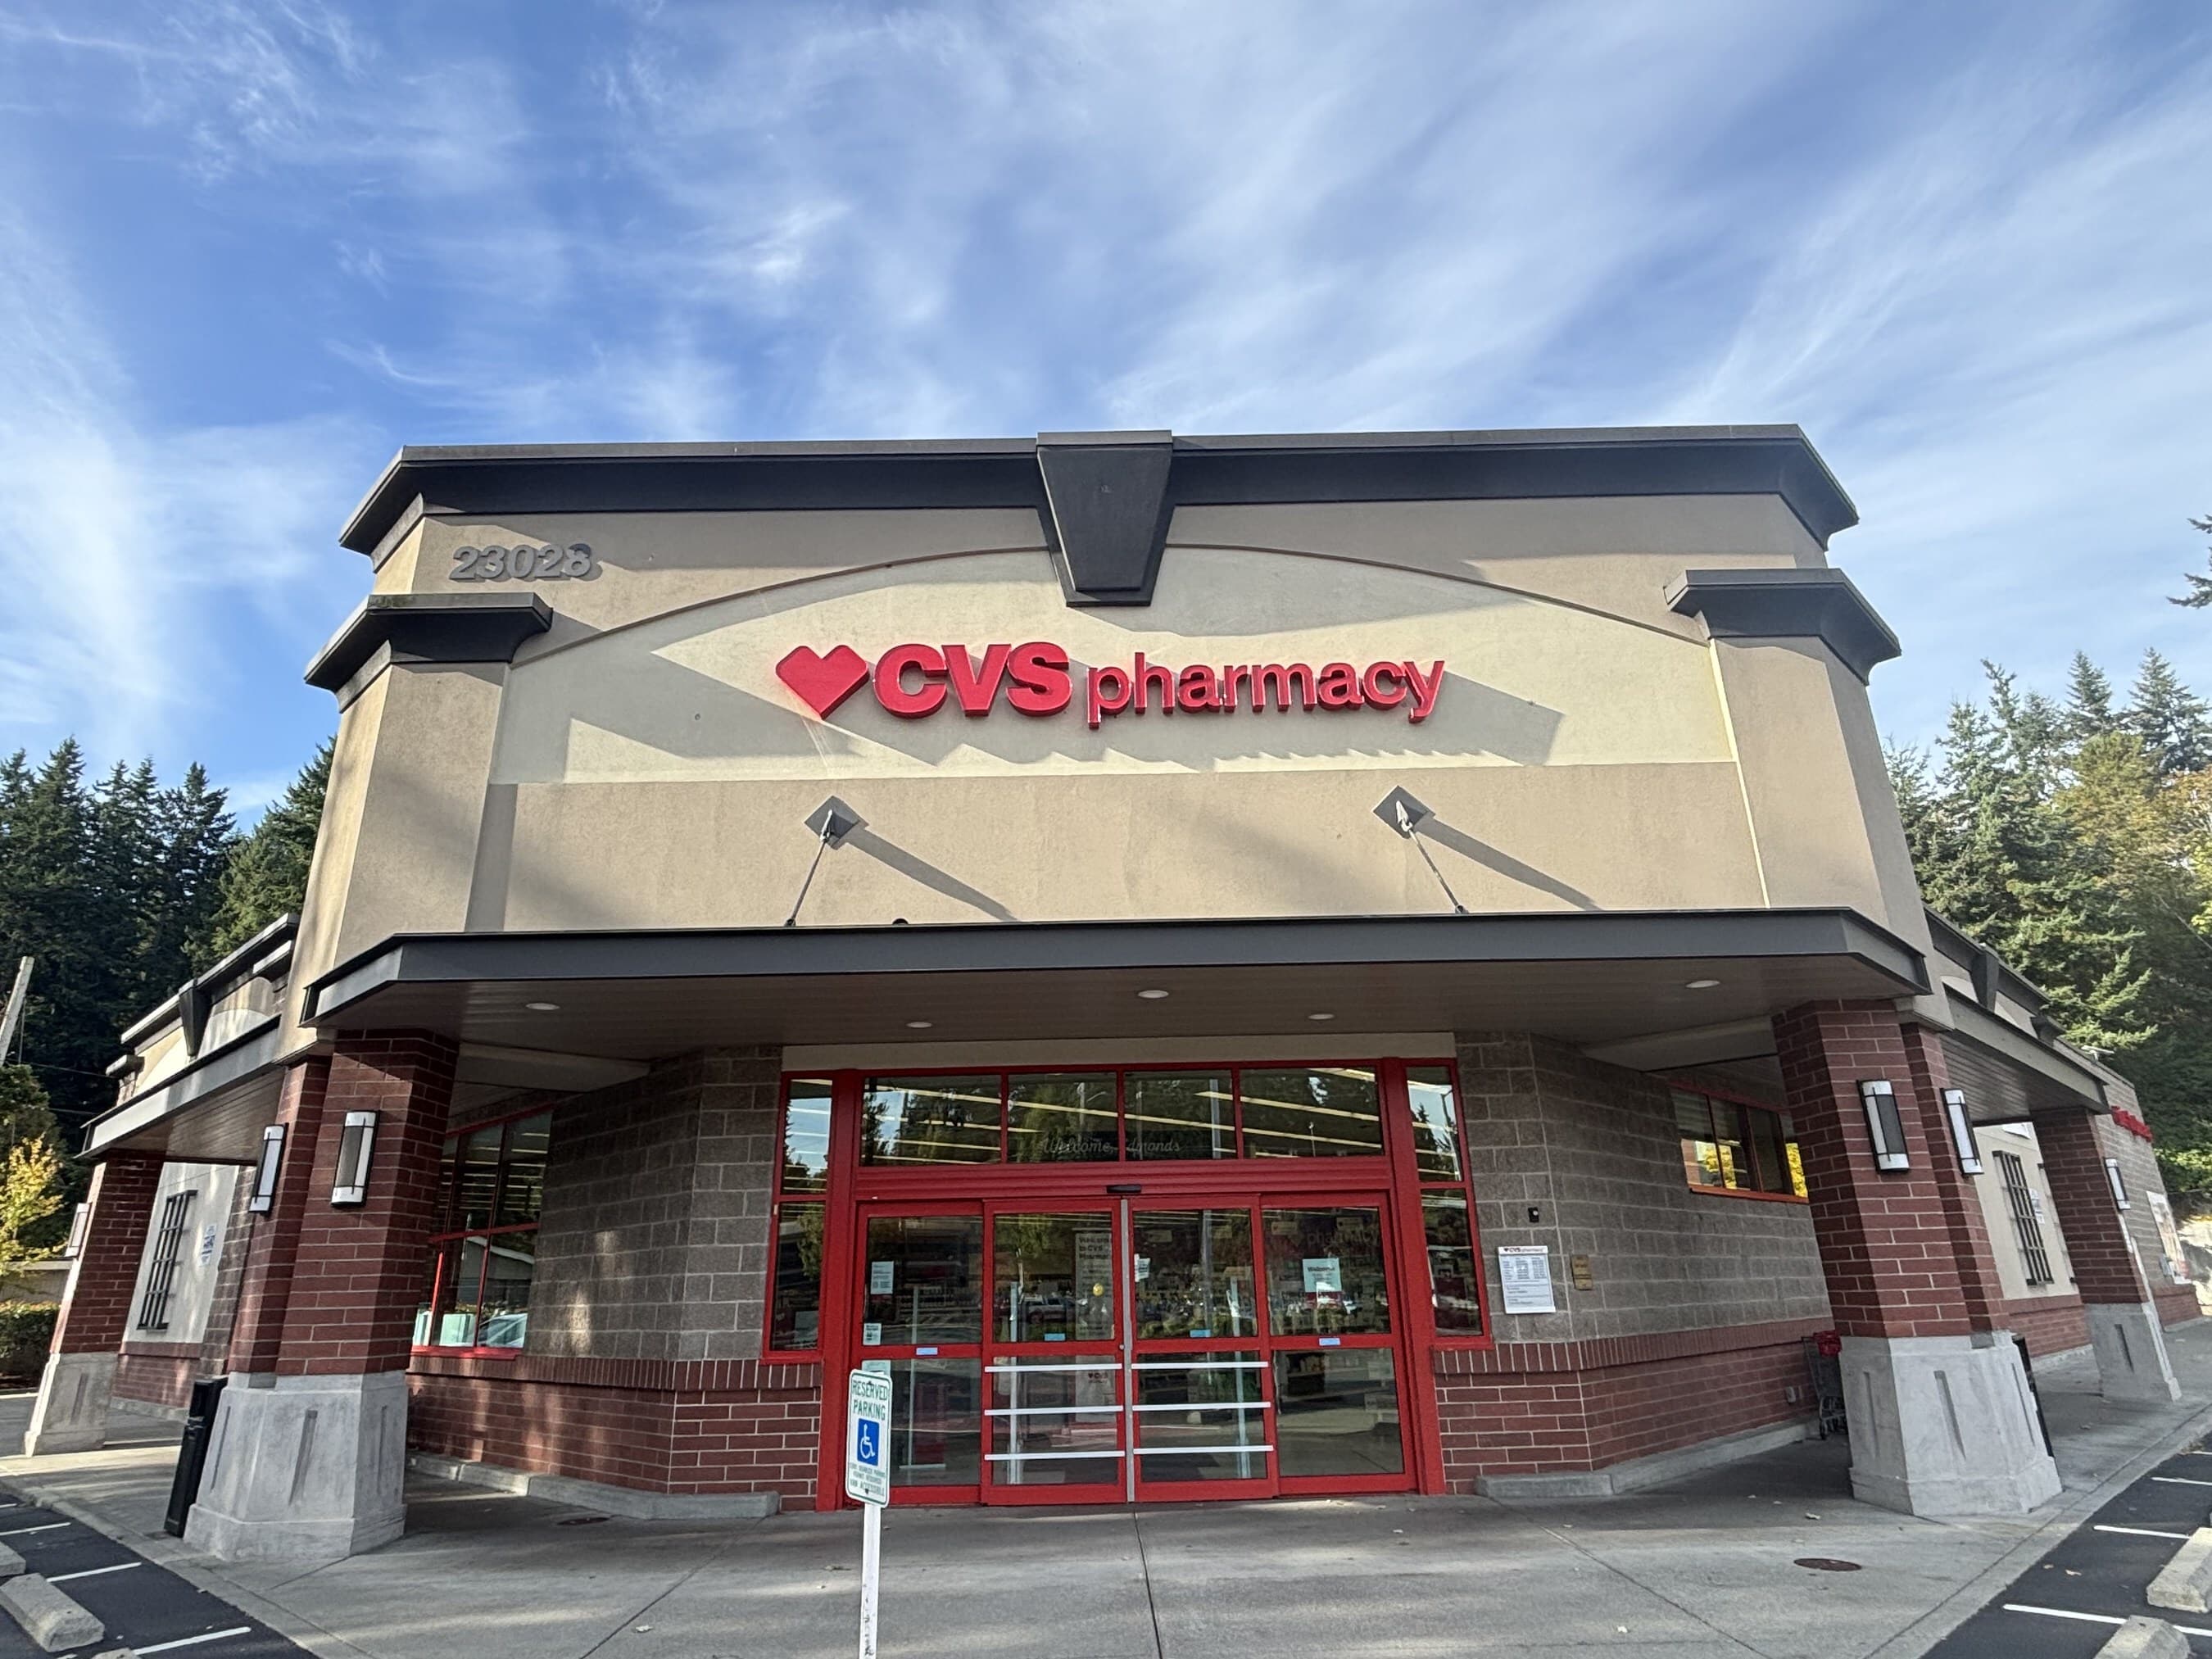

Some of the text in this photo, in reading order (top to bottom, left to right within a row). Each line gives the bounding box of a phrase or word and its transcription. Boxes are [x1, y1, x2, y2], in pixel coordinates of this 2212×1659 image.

[449, 542, 592, 579] 23028
[873, 641, 1445, 730] CVS pharmacy
[852, 1380, 887, 1401] RESERVED
[853, 1398, 886, 1421] PARKING
